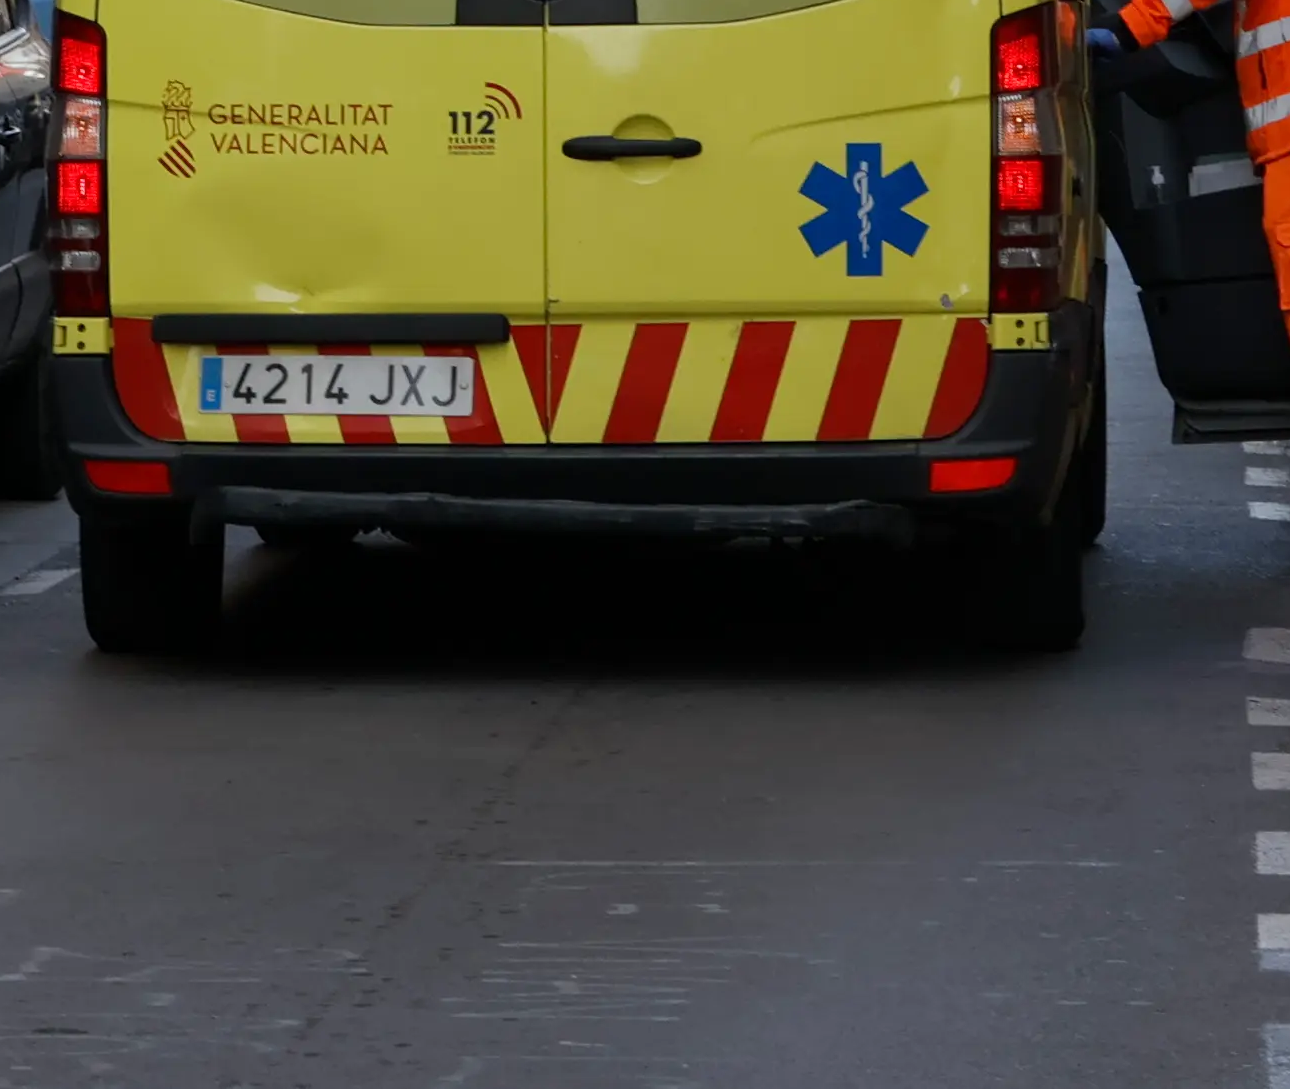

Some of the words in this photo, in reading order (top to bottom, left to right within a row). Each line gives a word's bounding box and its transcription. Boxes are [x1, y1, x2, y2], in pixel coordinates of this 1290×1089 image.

[208, 103, 393, 126] GENERALITAT
[448, 110, 495, 135] 112
[210, 133, 389, 155] VALENCIANA
[232, 363, 349, 405] 4214
[369, 364, 458, 407] JXJ
